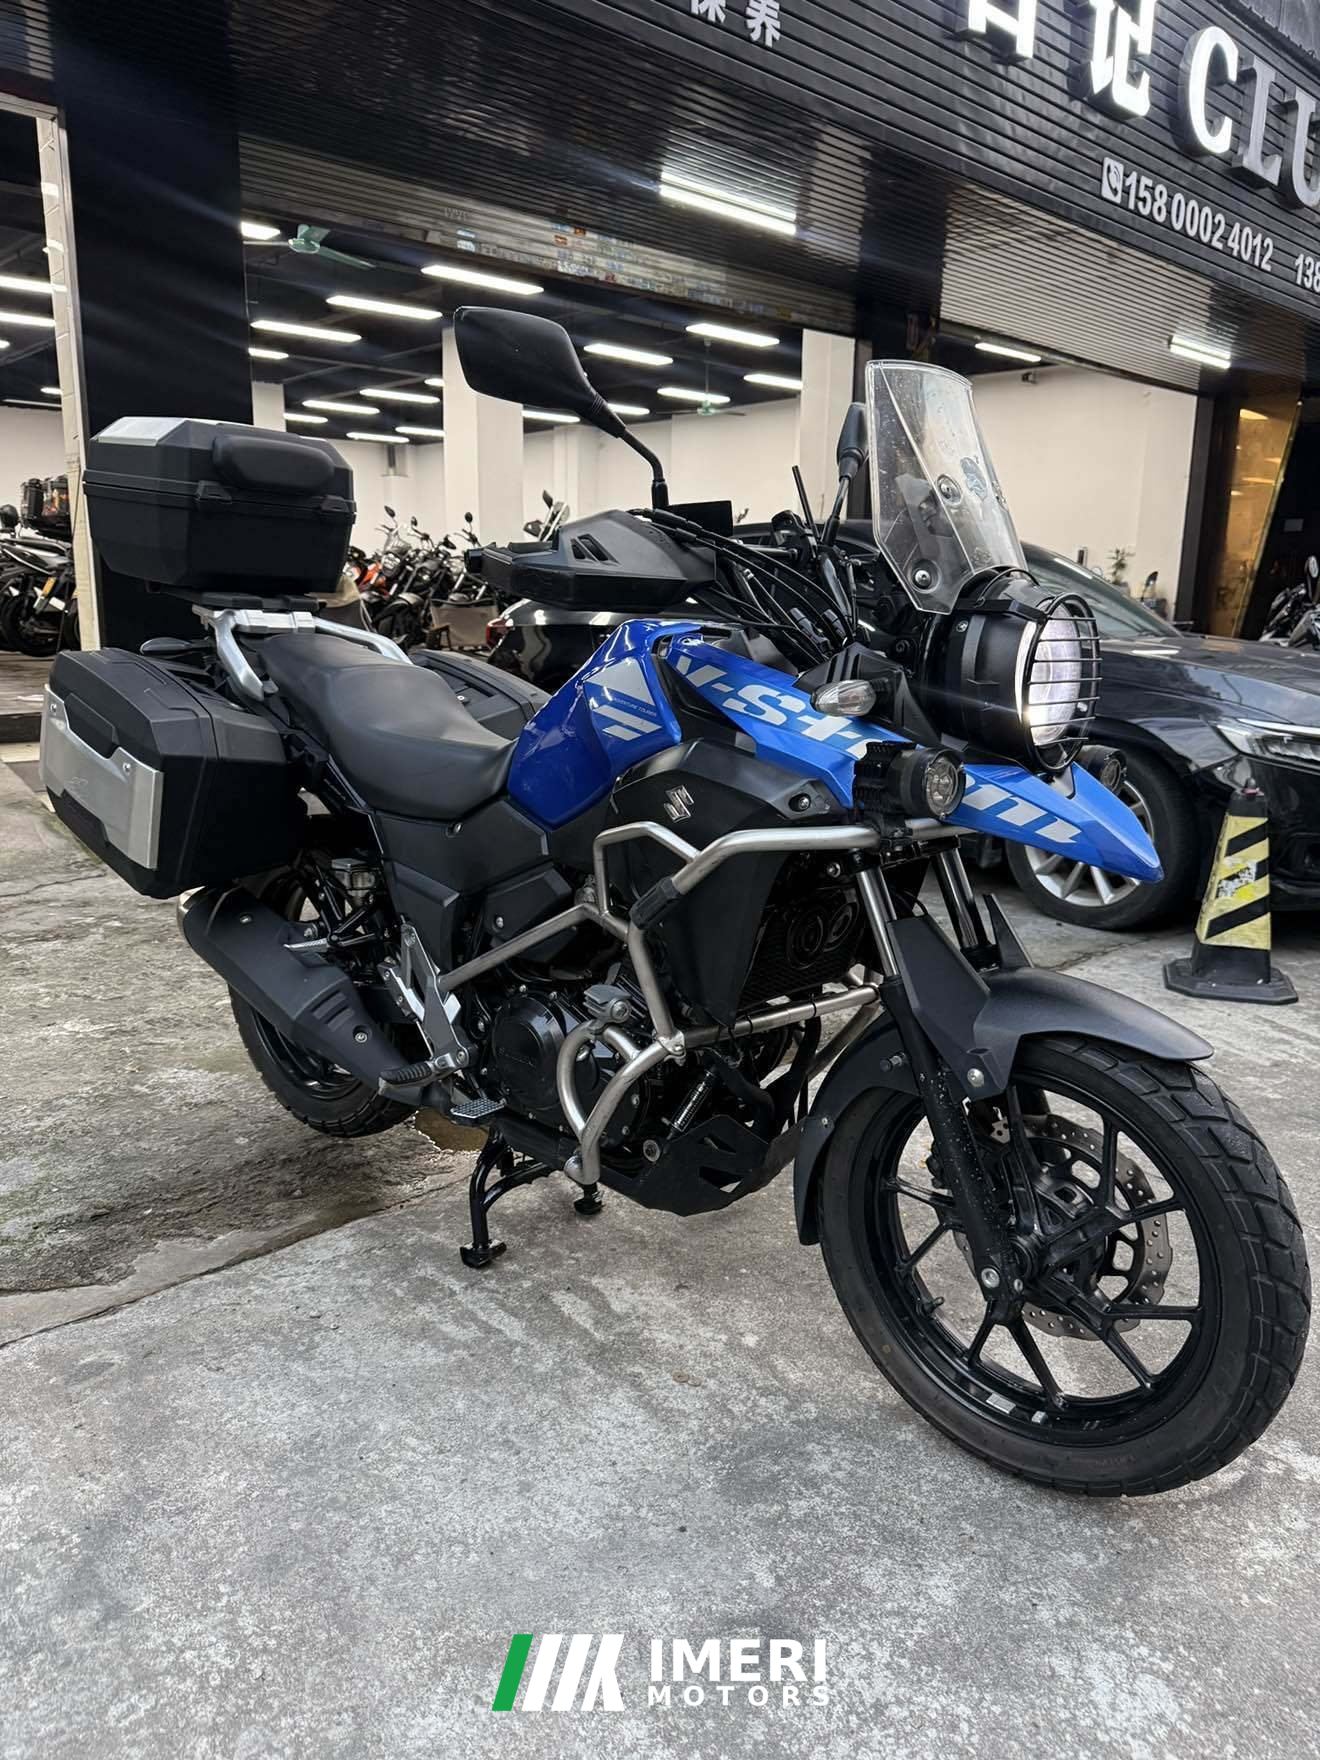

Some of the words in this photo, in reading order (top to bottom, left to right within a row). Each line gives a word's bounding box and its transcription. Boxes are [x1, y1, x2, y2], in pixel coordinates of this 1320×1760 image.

[1125, 171, 1168, 223] 158
[1170, 192, 1226, 250] 0002
[1227, 222, 1274, 272] 4012
